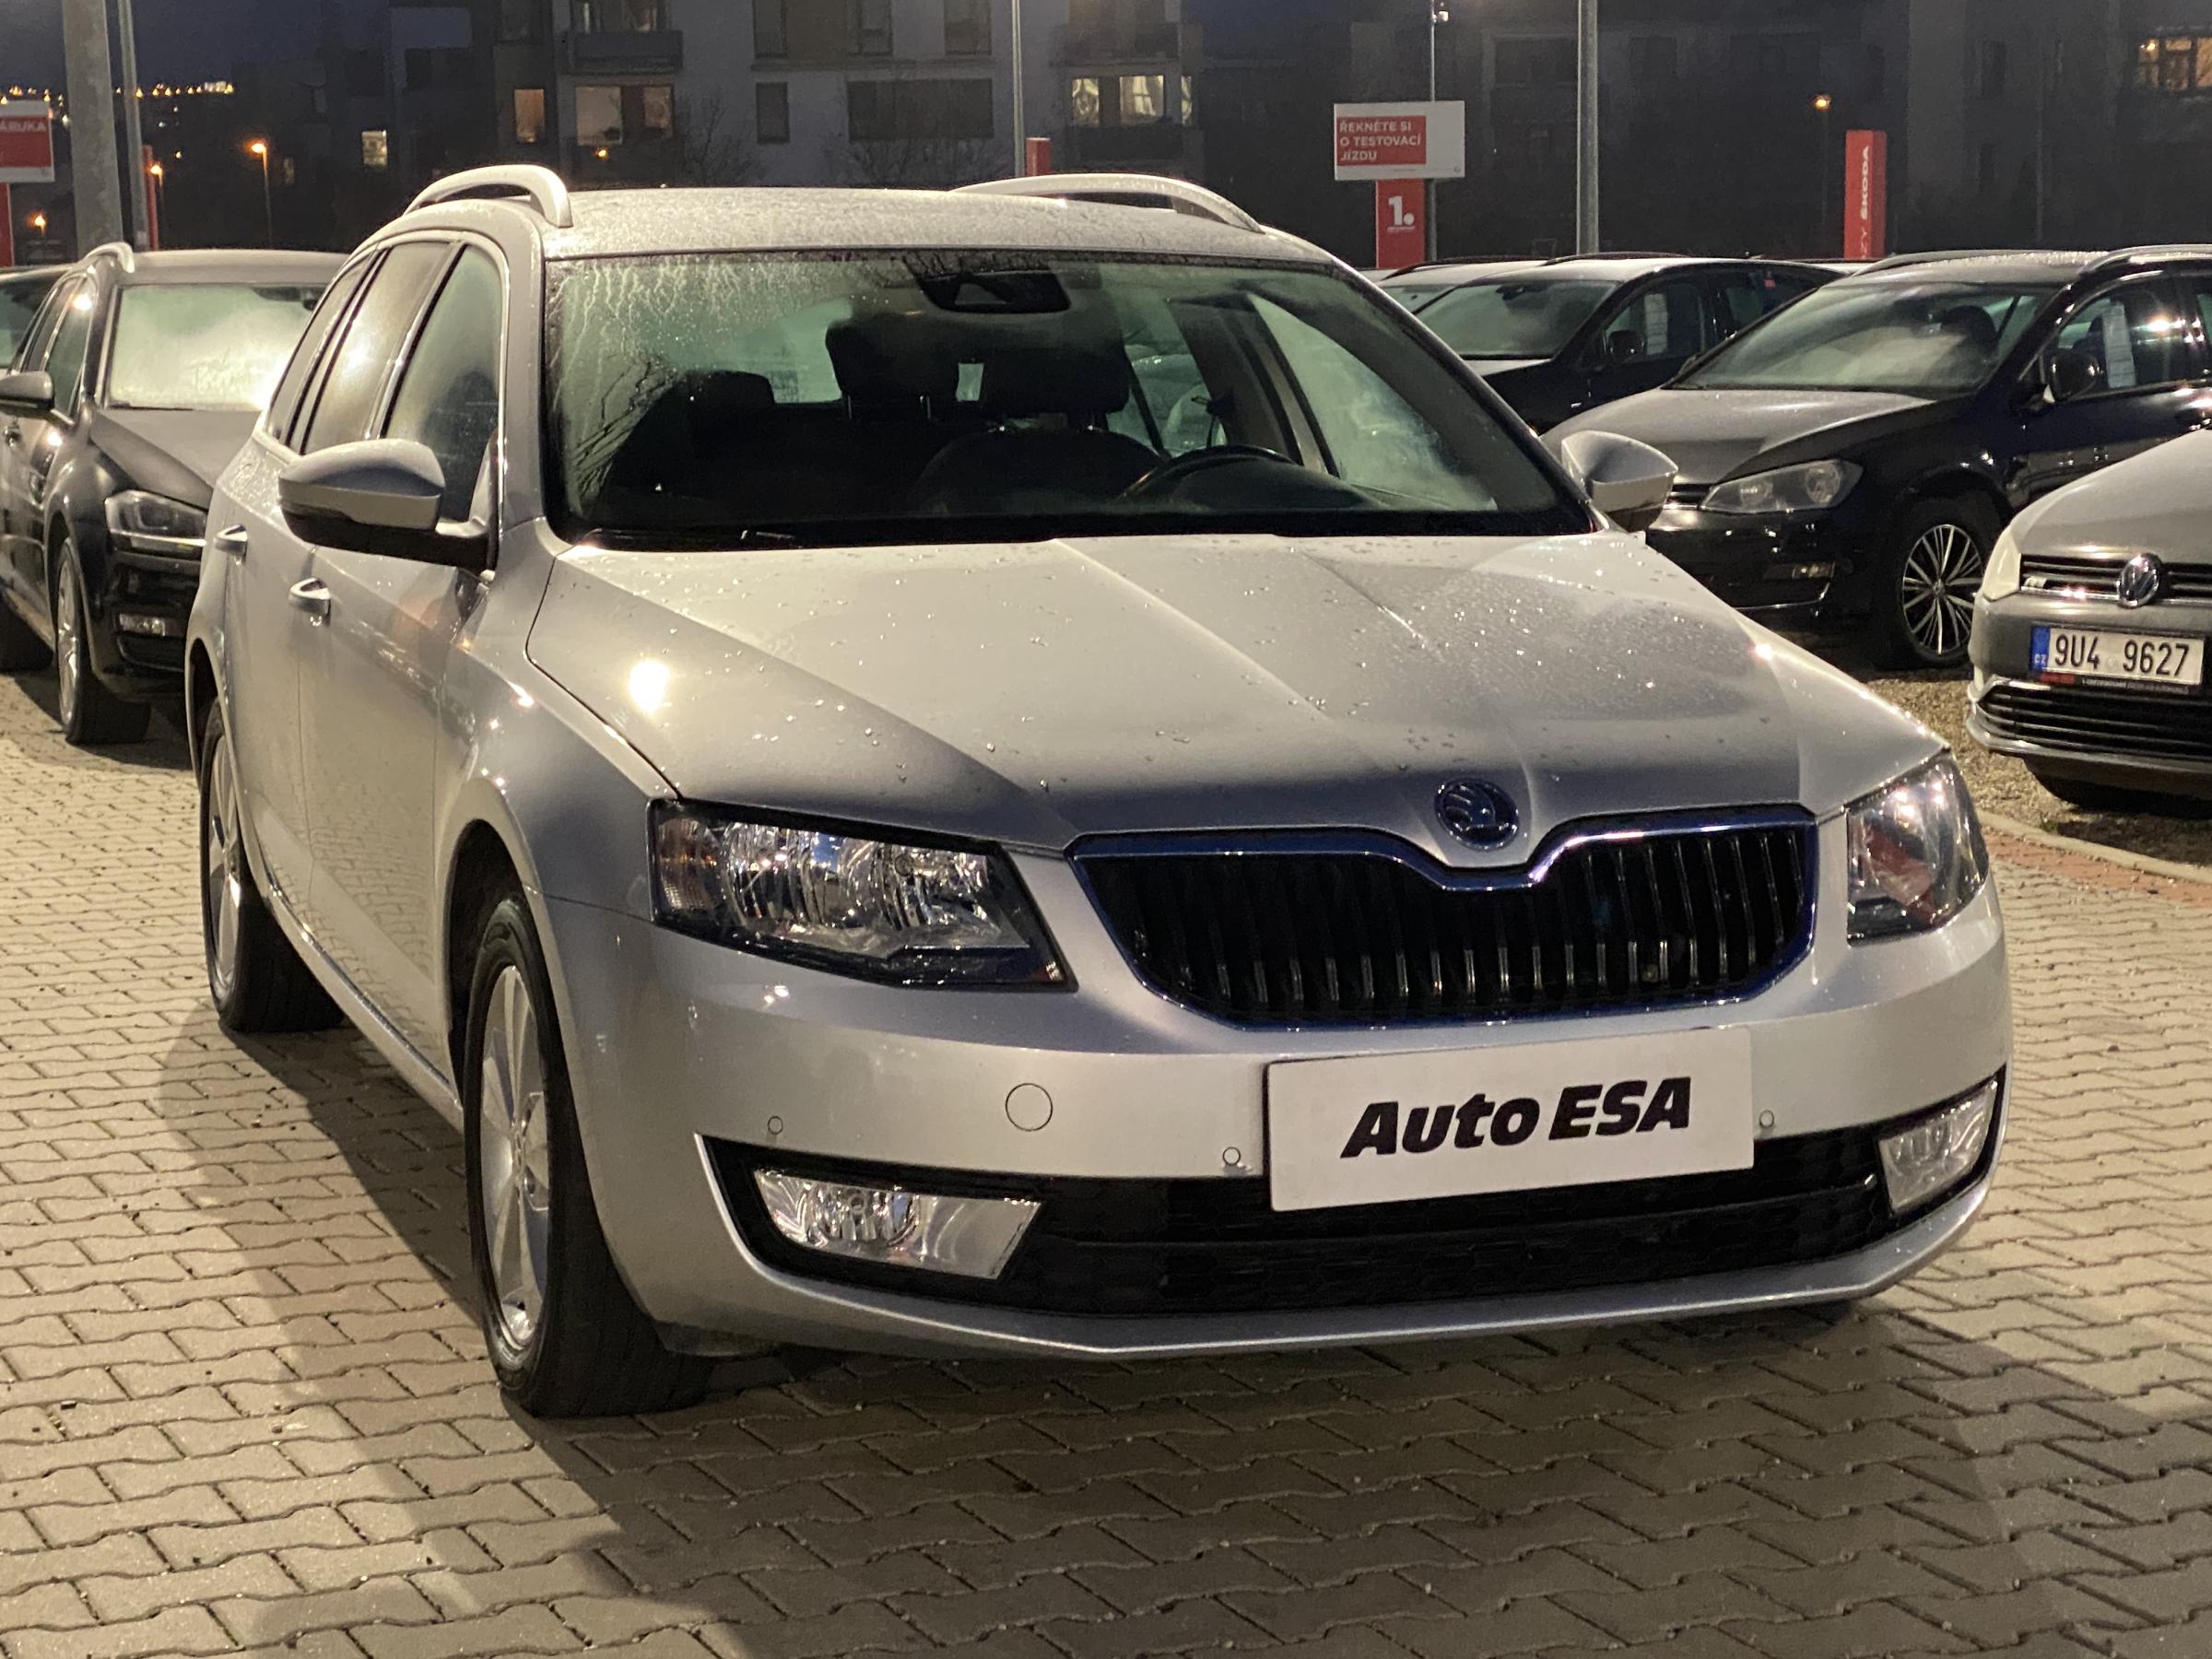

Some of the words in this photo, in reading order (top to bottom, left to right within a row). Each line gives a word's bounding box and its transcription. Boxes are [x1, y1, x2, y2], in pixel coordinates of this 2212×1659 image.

[1400, 121, 1412, 132] SI
[1339, 136, 1349, 147] O
[1353, 133, 1421, 147] TESTOVACÍ
[1340, 148, 1378, 161] JÍZDU
[2054, 633, 2100, 670] 9U4
[2123, 639, 2190, 677] 9627
[1339, 1093, 1541, 1159] Auto
[1548, 1076, 1692, 1142] ESA
